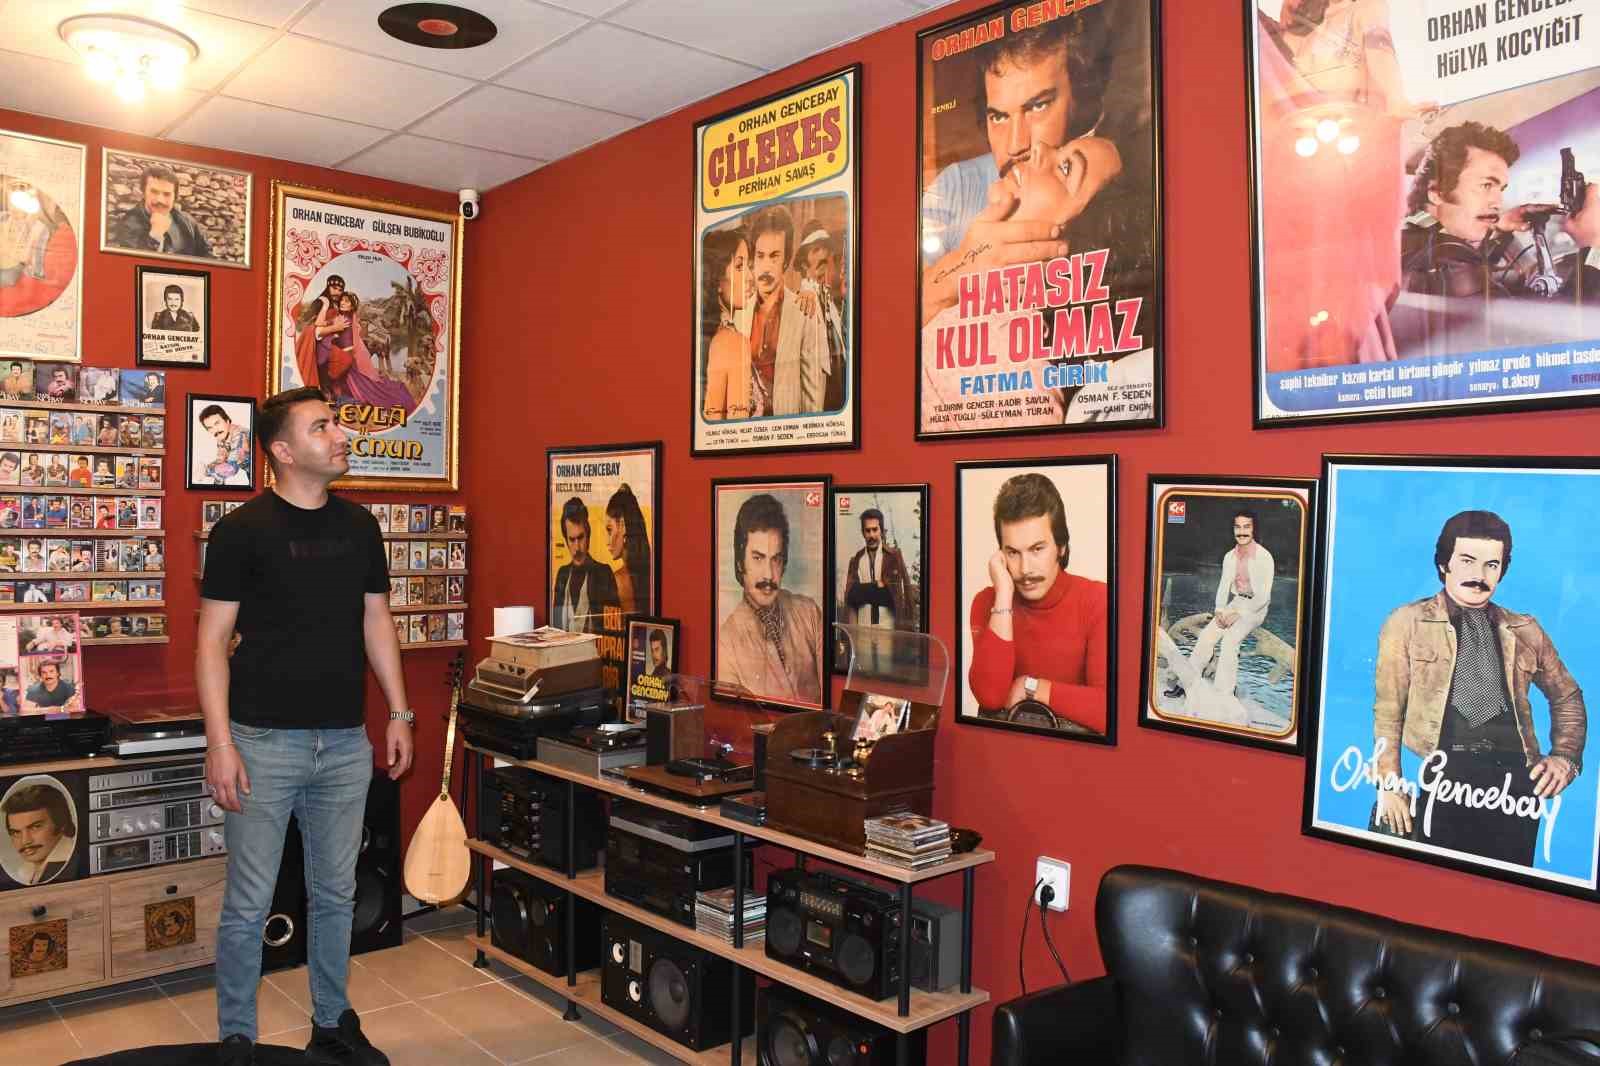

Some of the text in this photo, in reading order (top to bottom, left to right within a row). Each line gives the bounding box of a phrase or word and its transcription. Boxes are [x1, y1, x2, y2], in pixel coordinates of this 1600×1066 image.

[931, 16, 1005, 61] ORHAN
[1427, 3, 1487, 42] ORHAN
[1436, 42, 1488, 79] HÜLYA
[738, 86, 840, 133] ORHAN GENCEBAY
[708, 105, 842, 198] ÇİLEKEŞ
[738, 163, 816, 197] PERİHAN SAVAŞ
[292, 207, 322, 223] ORHAN
[324, 212, 365, 230] GENCEBAY
[958, 248, 1110, 320] HATASIZ
[936, 297, 1143, 371] KUL OLMAZ
[959, 360, 1109, 396] FATMA GİRİK
[1025, 395, 1050, 405] SAVUN
[1027, 406, 1054, 417] TURAN
[1077, 393, 1109, 404] OSMAN
[1121, 390, 1152, 400] SEDEN
[556, 462, 620, 478] ORHAN GENCEBAY
[1330, 737, 1563, 864] Orhan Gencebay
